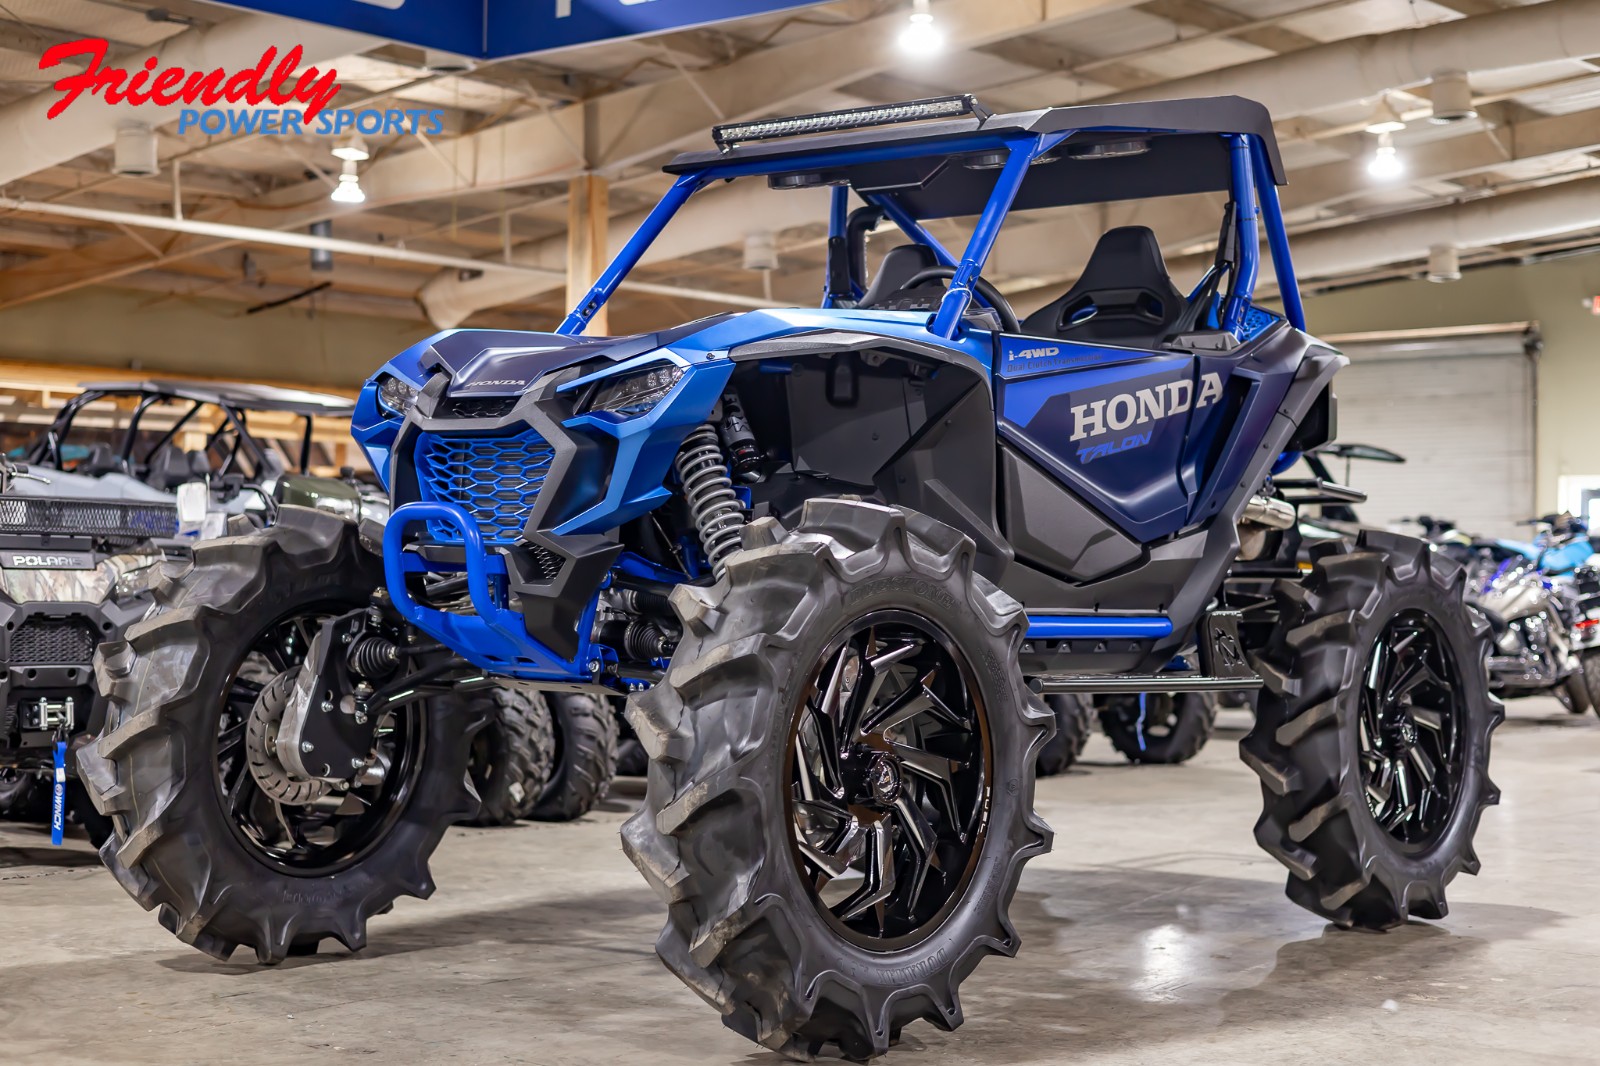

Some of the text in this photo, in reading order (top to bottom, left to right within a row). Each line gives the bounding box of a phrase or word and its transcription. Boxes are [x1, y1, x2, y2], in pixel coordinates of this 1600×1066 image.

[1008, 347, 1060, 361] i-4WD
[1007, 363, 1025, 372] Dual
[1028, 359, 1052, 370] Clutch
[464, 379, 526, 388] HONDA
[1069, 371, 1224, 442] HONDA
[1075, 430, 1153, 464] TALON
[12, 555, 82, 567] POLARIS
[53, 795, 63, 831] WINCH
